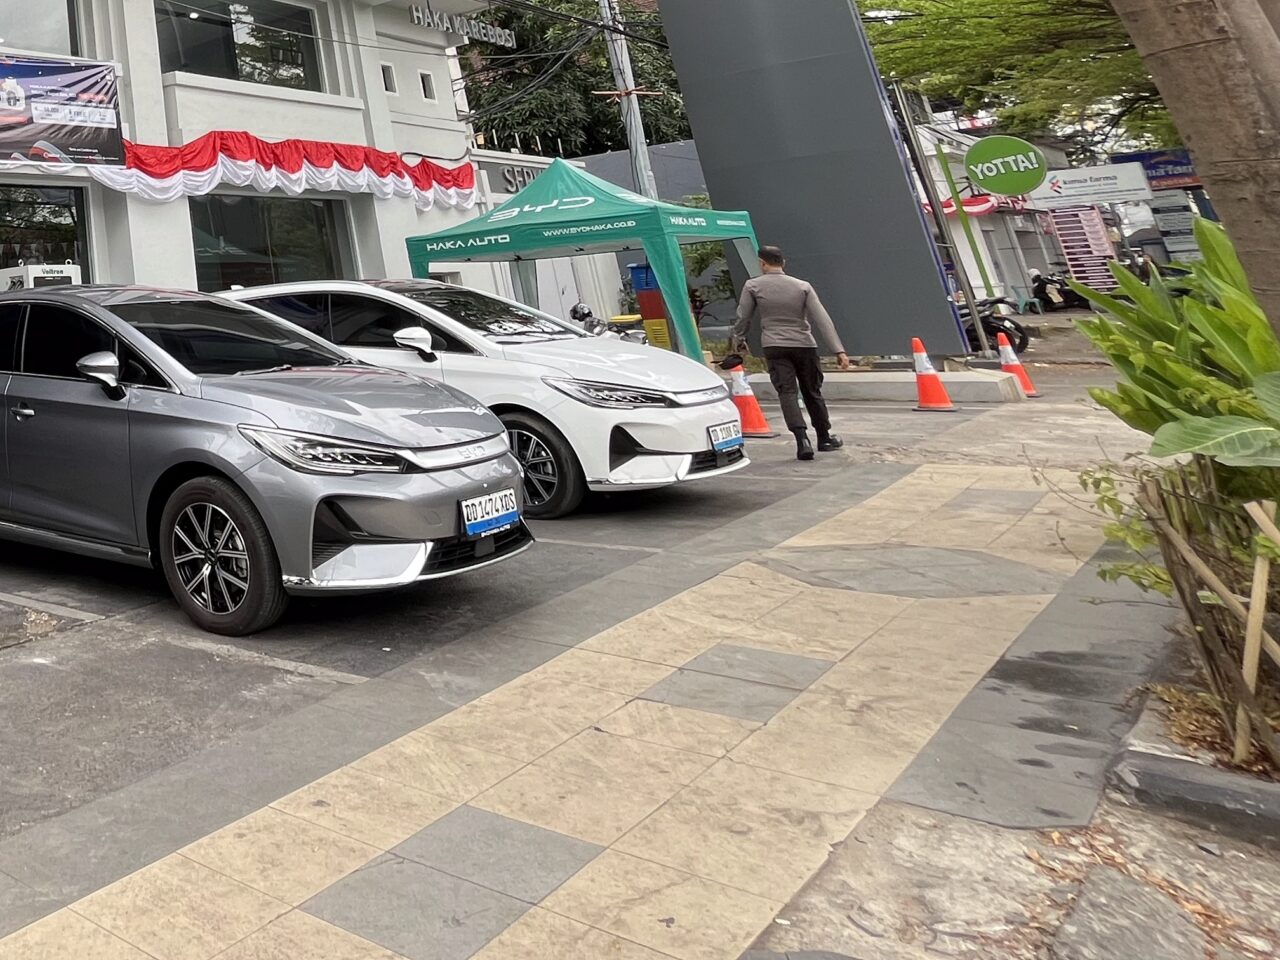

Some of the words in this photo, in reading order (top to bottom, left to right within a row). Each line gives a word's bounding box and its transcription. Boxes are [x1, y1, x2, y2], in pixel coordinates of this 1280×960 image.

[409, 4, 453, 32] HAKA
[453, 15, 517, 49] KAREBOSI
[970, 152, 1039, 180] YOTTA!
[487, 196, 596, 222] BYD
[542, 220, 637, 238] WWW.BYDHAKA.CO.ID
[426, 240, 466, 252] HAKA
[467, 234, 510, 247] AUTO
[464, 504, 478, 522] DD
[480, 497, 500, 519] 1474
[500, 493, 515, 511] XDS
